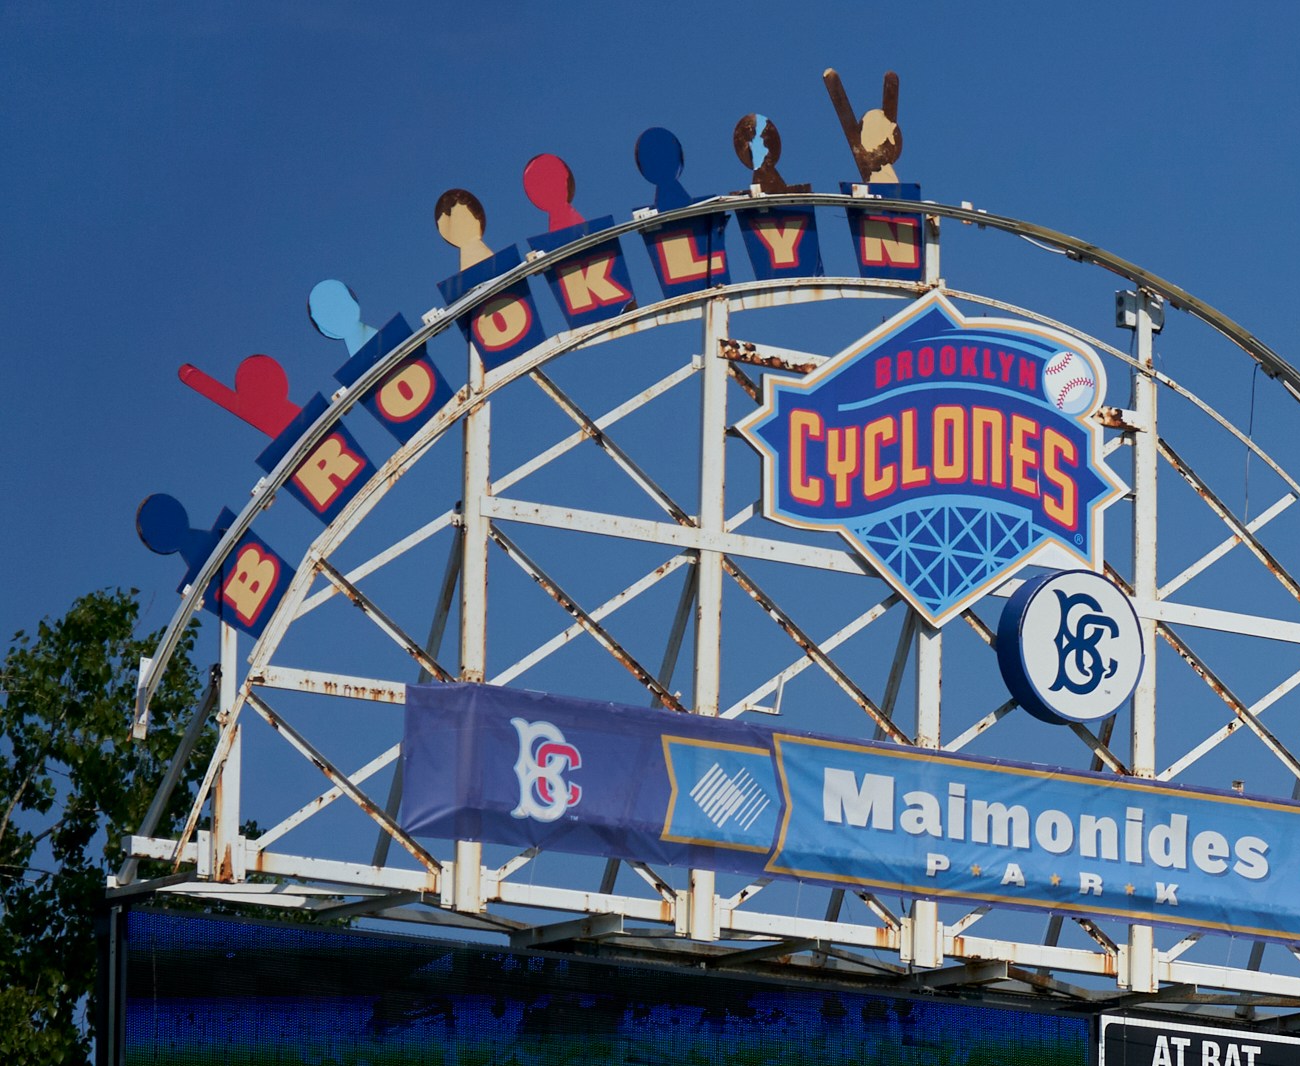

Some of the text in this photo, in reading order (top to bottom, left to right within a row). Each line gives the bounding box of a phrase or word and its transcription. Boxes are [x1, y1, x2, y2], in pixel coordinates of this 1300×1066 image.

[216, 213, 921, 628] BROOKLYN
[875, 345, 1038, 390] BROOKLYN
[788, 404, 1079, 532] CYCLONES
[823, 767, 1271, 881] Maimonides
